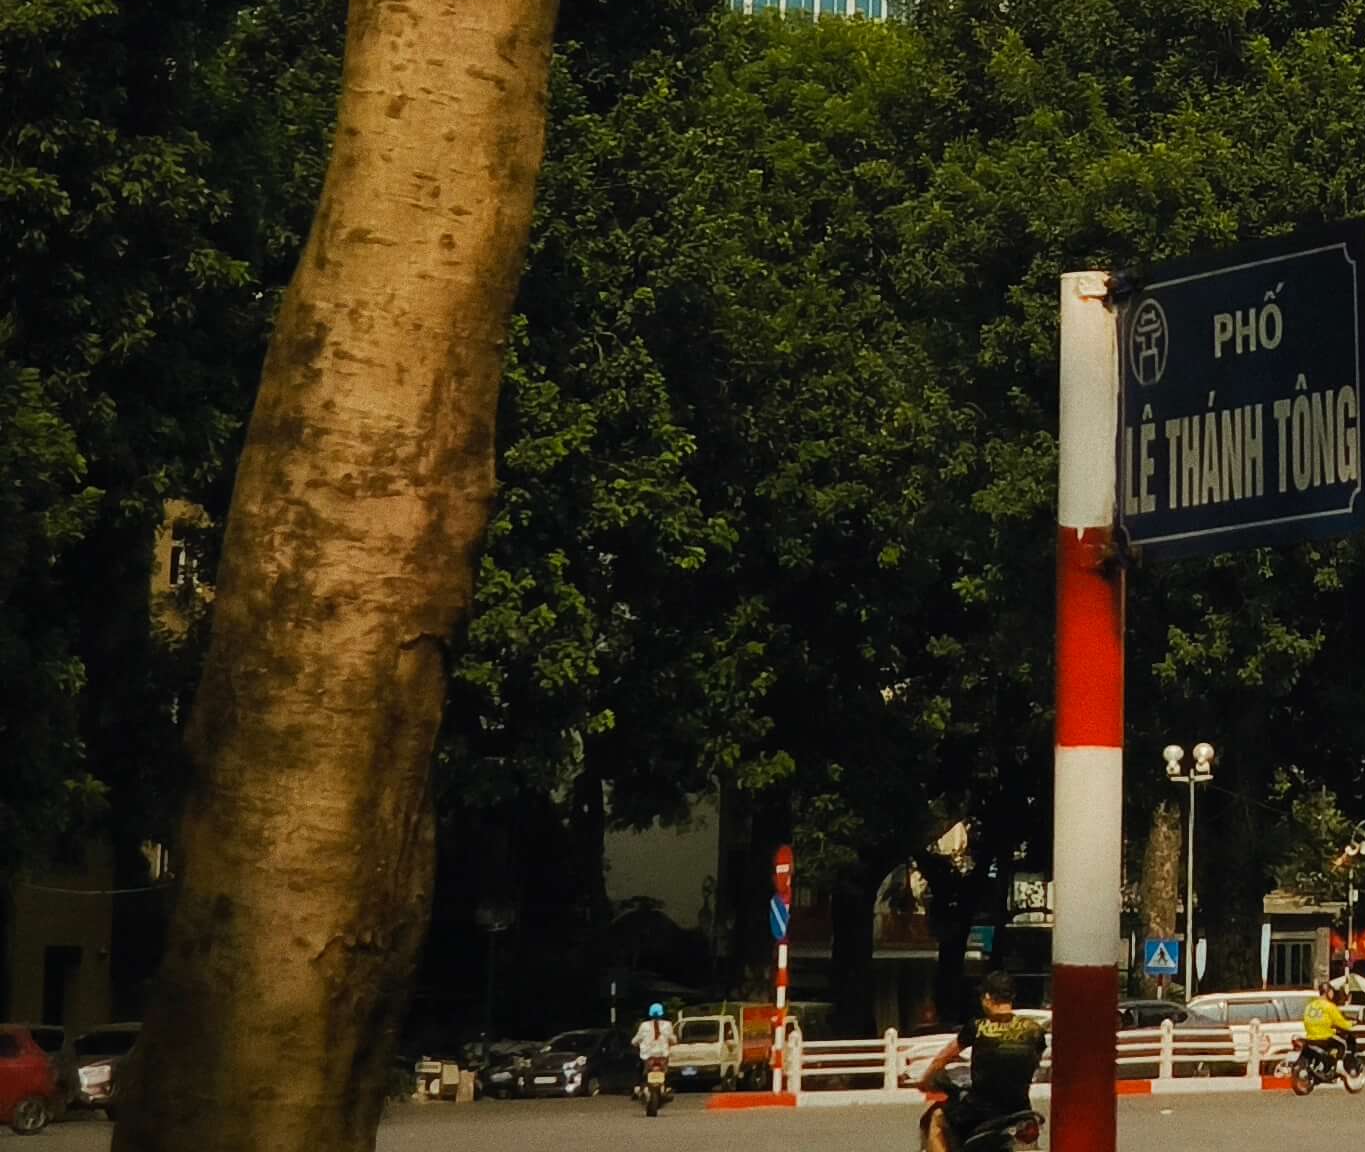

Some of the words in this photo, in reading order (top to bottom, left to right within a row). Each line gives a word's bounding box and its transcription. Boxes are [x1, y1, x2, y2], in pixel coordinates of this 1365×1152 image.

[1213, 281, 1285, 359] PHỐ
[1124, 403, 1157, 516] LÊ
[1165, 390, 1265, 510] THÁNH
[1272, 373, 1359, 494] TÔNG
